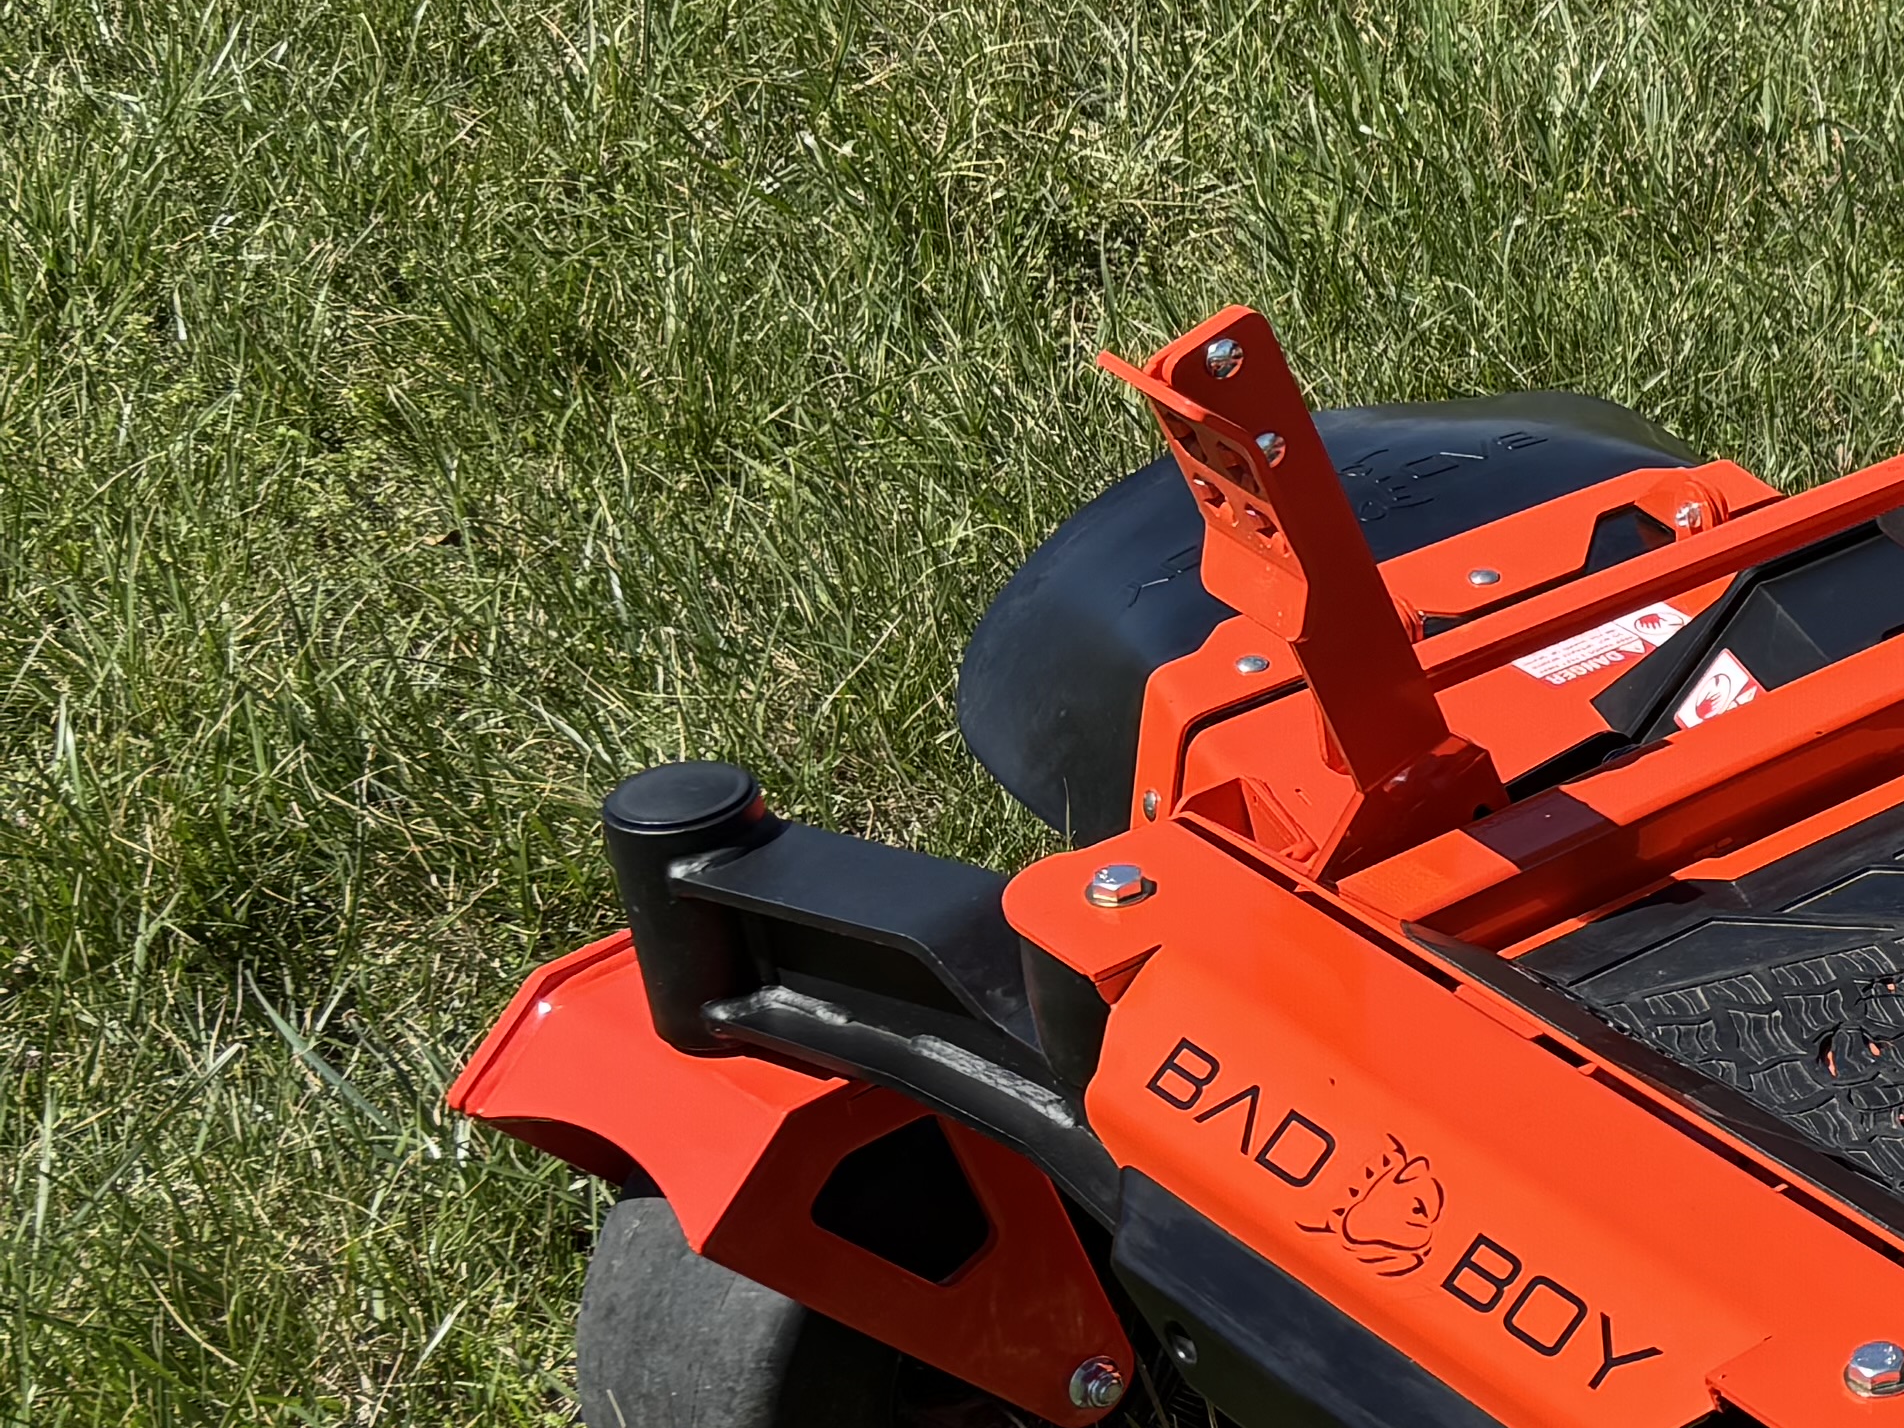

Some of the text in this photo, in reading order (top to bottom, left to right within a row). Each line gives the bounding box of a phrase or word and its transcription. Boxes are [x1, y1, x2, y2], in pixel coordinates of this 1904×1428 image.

[1544, 649, 1626, 686] DANGER
[1146, 1037, 1663, 1392] BAD BOY
